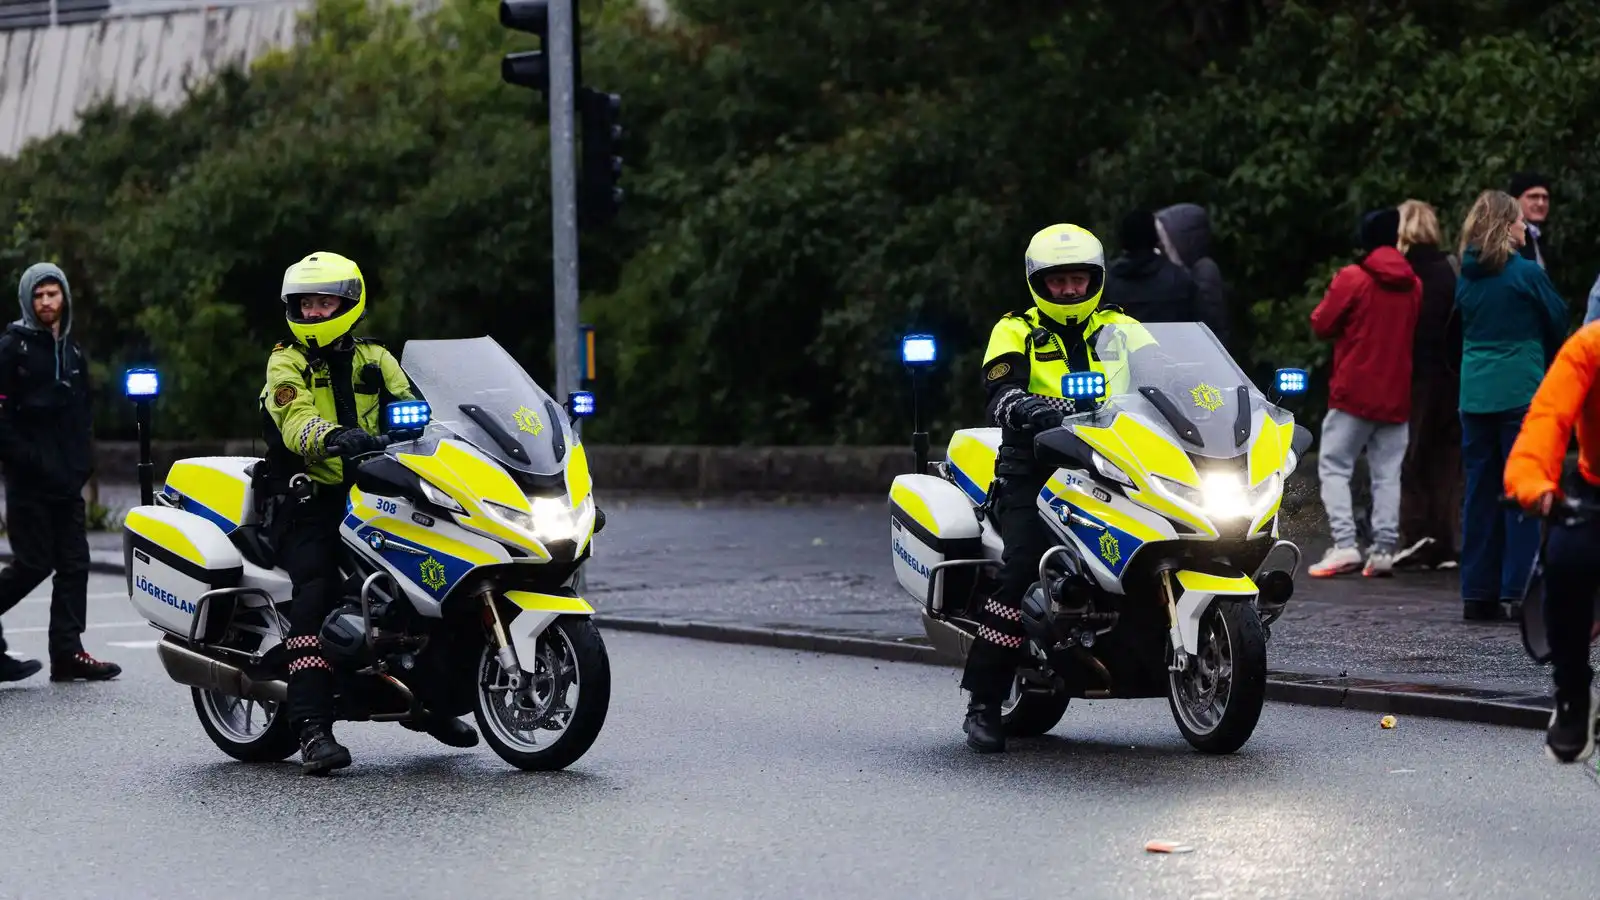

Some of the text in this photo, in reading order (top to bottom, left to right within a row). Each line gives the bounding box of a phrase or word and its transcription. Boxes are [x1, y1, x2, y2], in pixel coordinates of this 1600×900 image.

[376, 498, 397, 514] 308
[893, 538, 932, 579] LÖGREGLAN
[136, 575, 197, 614] LÖGREGLAN
